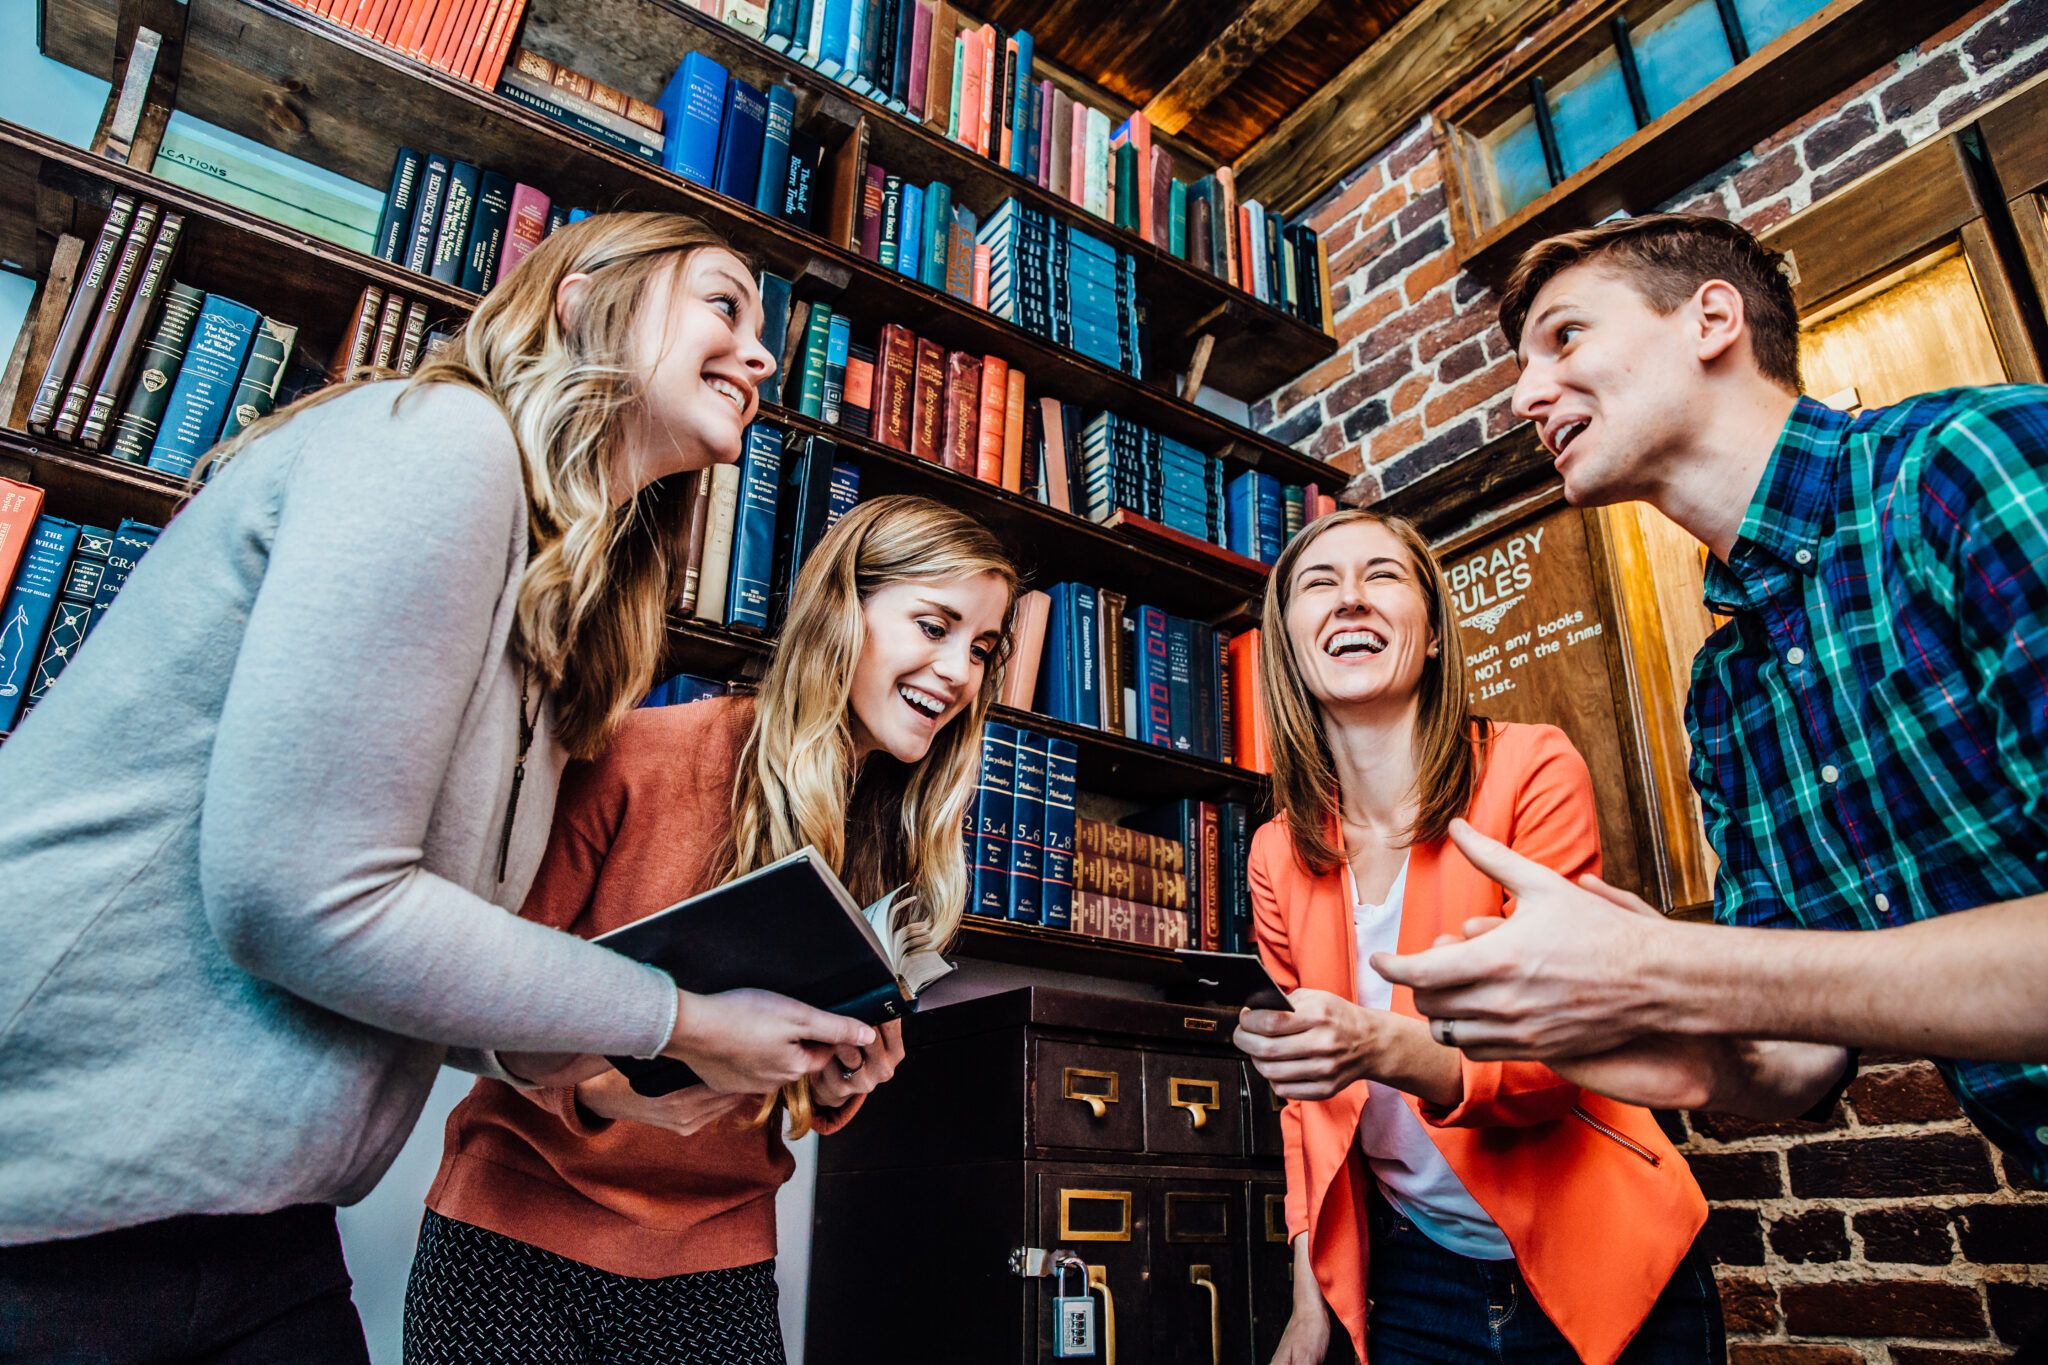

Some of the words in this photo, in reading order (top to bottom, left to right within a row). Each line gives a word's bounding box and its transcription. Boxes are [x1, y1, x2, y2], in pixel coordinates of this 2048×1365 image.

[788, 155, 801, 187] Bizarre
[801, 168, 810, 185] The
[449, 177, 461, 200] About
[457, 185, 467, 198] All
[798, 184, 808, 202] Book
[421, 173, 441, 226] REDNECKS
[446, 200, 455, 214] the
[453, 197, 464, 209] You
[785, 187, 798, 215] Truths
[887, 196, 898, 216] Great
[442, 213, 453, 235] Music
[449, 208, 461, 231] Need
[885, 217, 896, 240] Books
[419, 226, 430, 235] &
[100, 239, 114, 254] THE
[434, 234, 446, 266] Business
[443, 239, 455, 262] Know
[489, 228, 499, 259] PORTRAIT
[124, 249, 137, 265] THE
[149, 258, 163, 271] THE
[86, 252, 107, 289] GAMBLERS
[482, 268, 492, 292] KILLER
[957, 243, 972, 299] SCOTT
[103, 261, 133, 314] TRAILBLAZERS
[140, 271, 158, 298] MINERS
[203, 331, 237, 347] Anthology
[205, 322, 218, 332] The
[218, 327, 241, 341] Norton
[359, 331, 370, 345] THE
[196, 343, 236, 362] Masterpieces
[213, 341, 232, 352] World
[381, 340, 392, 354] THE
[403, 349, 415, 362] THE
[253, 352, 280, 365] CERVANTES
[889, 374, 907, 437] dictionary
[921, 386, 938, 448] dictionary
[955, 400, 972, 460] dictionary
[44, 530, 63, 541] THE
[35, 539, 65, 552] WHALE
[37, 556, 54, 565] Search
[37, 566, 56, 575] Giants
[16, 585, 33, 595] PHILIP
[33, 589, 51, 598] HOARE
[1082, 615, 1092, 659] Grassroots
[1505, 631, 1532, 651] any
[1537, 610, 1584, 639] books
[1220, 645, 1229, 666] THE
[1474, 660, 1503, 682] NOT
[1509, 653, 1529, 669] on
[1534, 638, 1561, 659] the
[1083, 659, 1092, 691] Women
[1221, 671, 1231, 722] AMATEUR
[1480, 677, 1517, 700] list.
[964, 815, 973, 830] 2
[983, 817, 992, 832] 3
[999, 822, 1007, 836] 4
[1017, 824, 1027, 838] 5
[1033, 829, 1040, 842] 6
[1049, 832, 1058, 846] 7
[1064, 836, 1072, 849] 8
